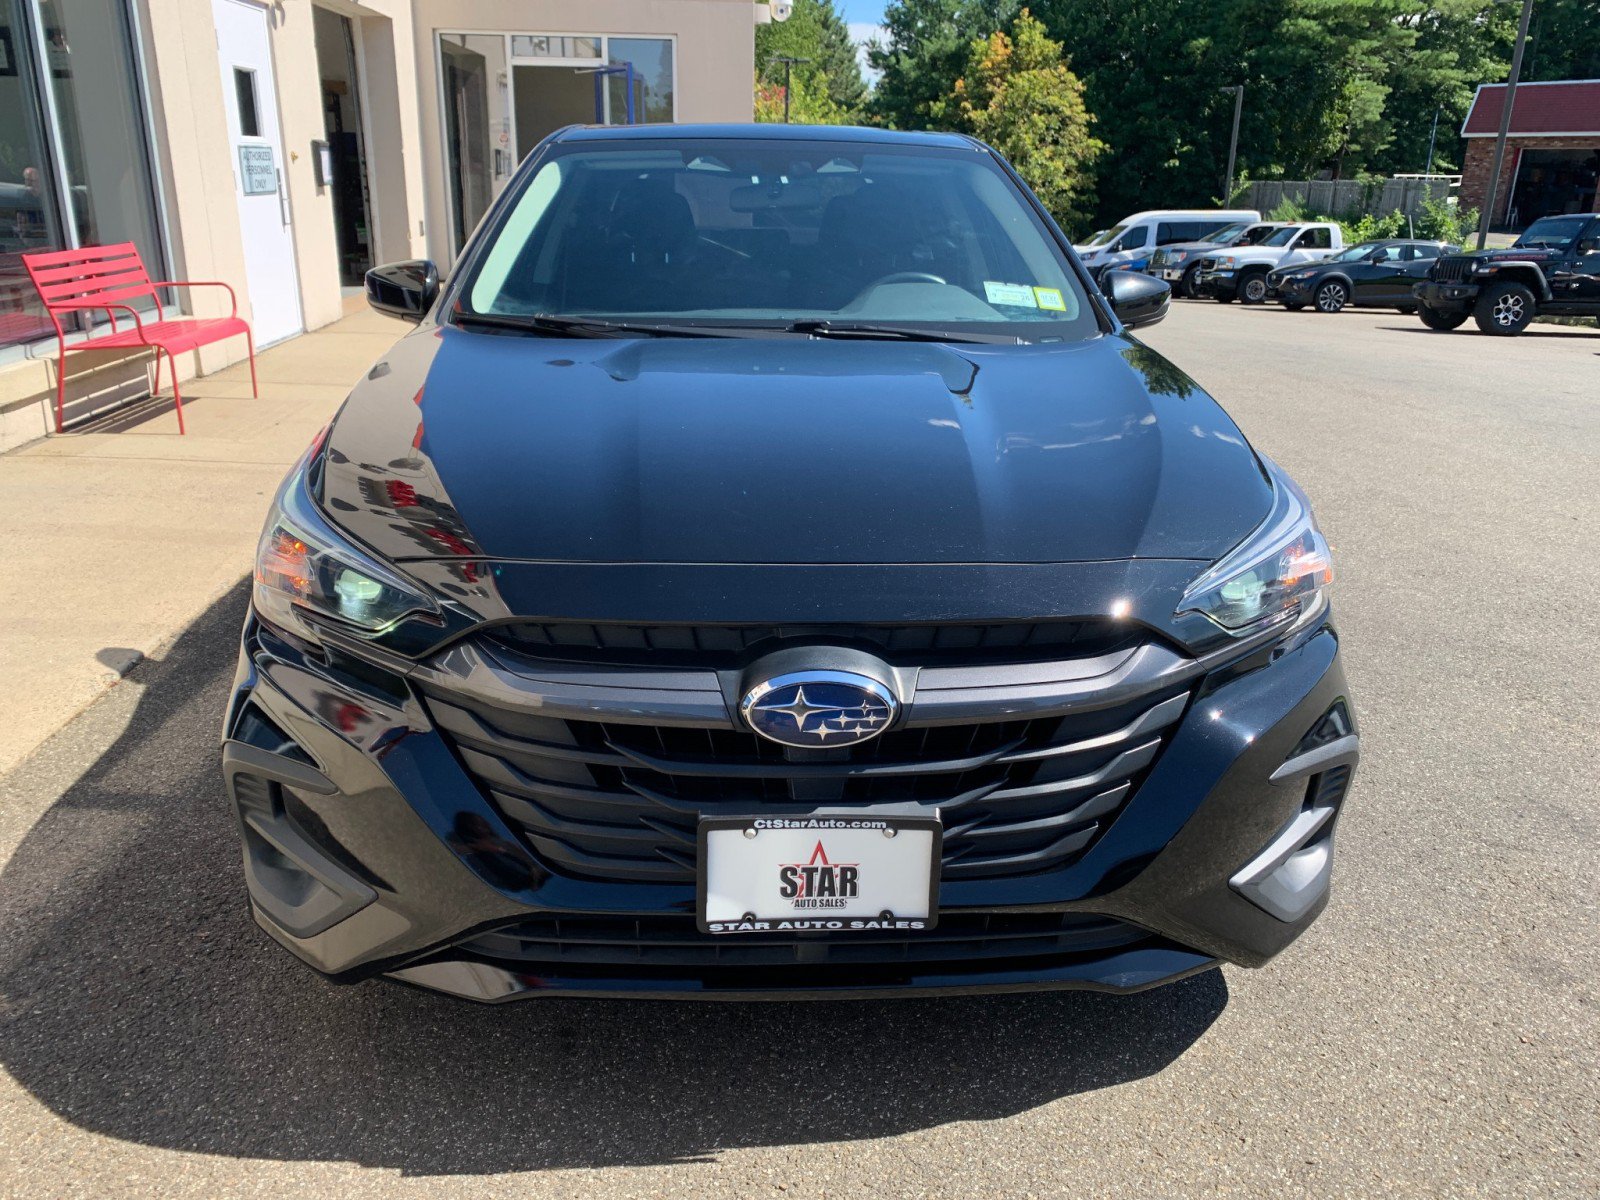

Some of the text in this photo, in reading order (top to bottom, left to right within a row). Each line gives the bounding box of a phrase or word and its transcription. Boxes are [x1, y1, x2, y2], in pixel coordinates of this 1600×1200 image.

[243, 151, 271, 161] AUTHORIZED
[245, 164, 272, 176] PERSONNEL
[254, 179, 267, 189] ONLY
[753, 818, 887, 829] CtStarAuto.com
[779, 866, 858, 898] STAR
[794, 898, 845, 908] AUTO SALES
[709, 920, 925, 931] STAR AUTO SALES
